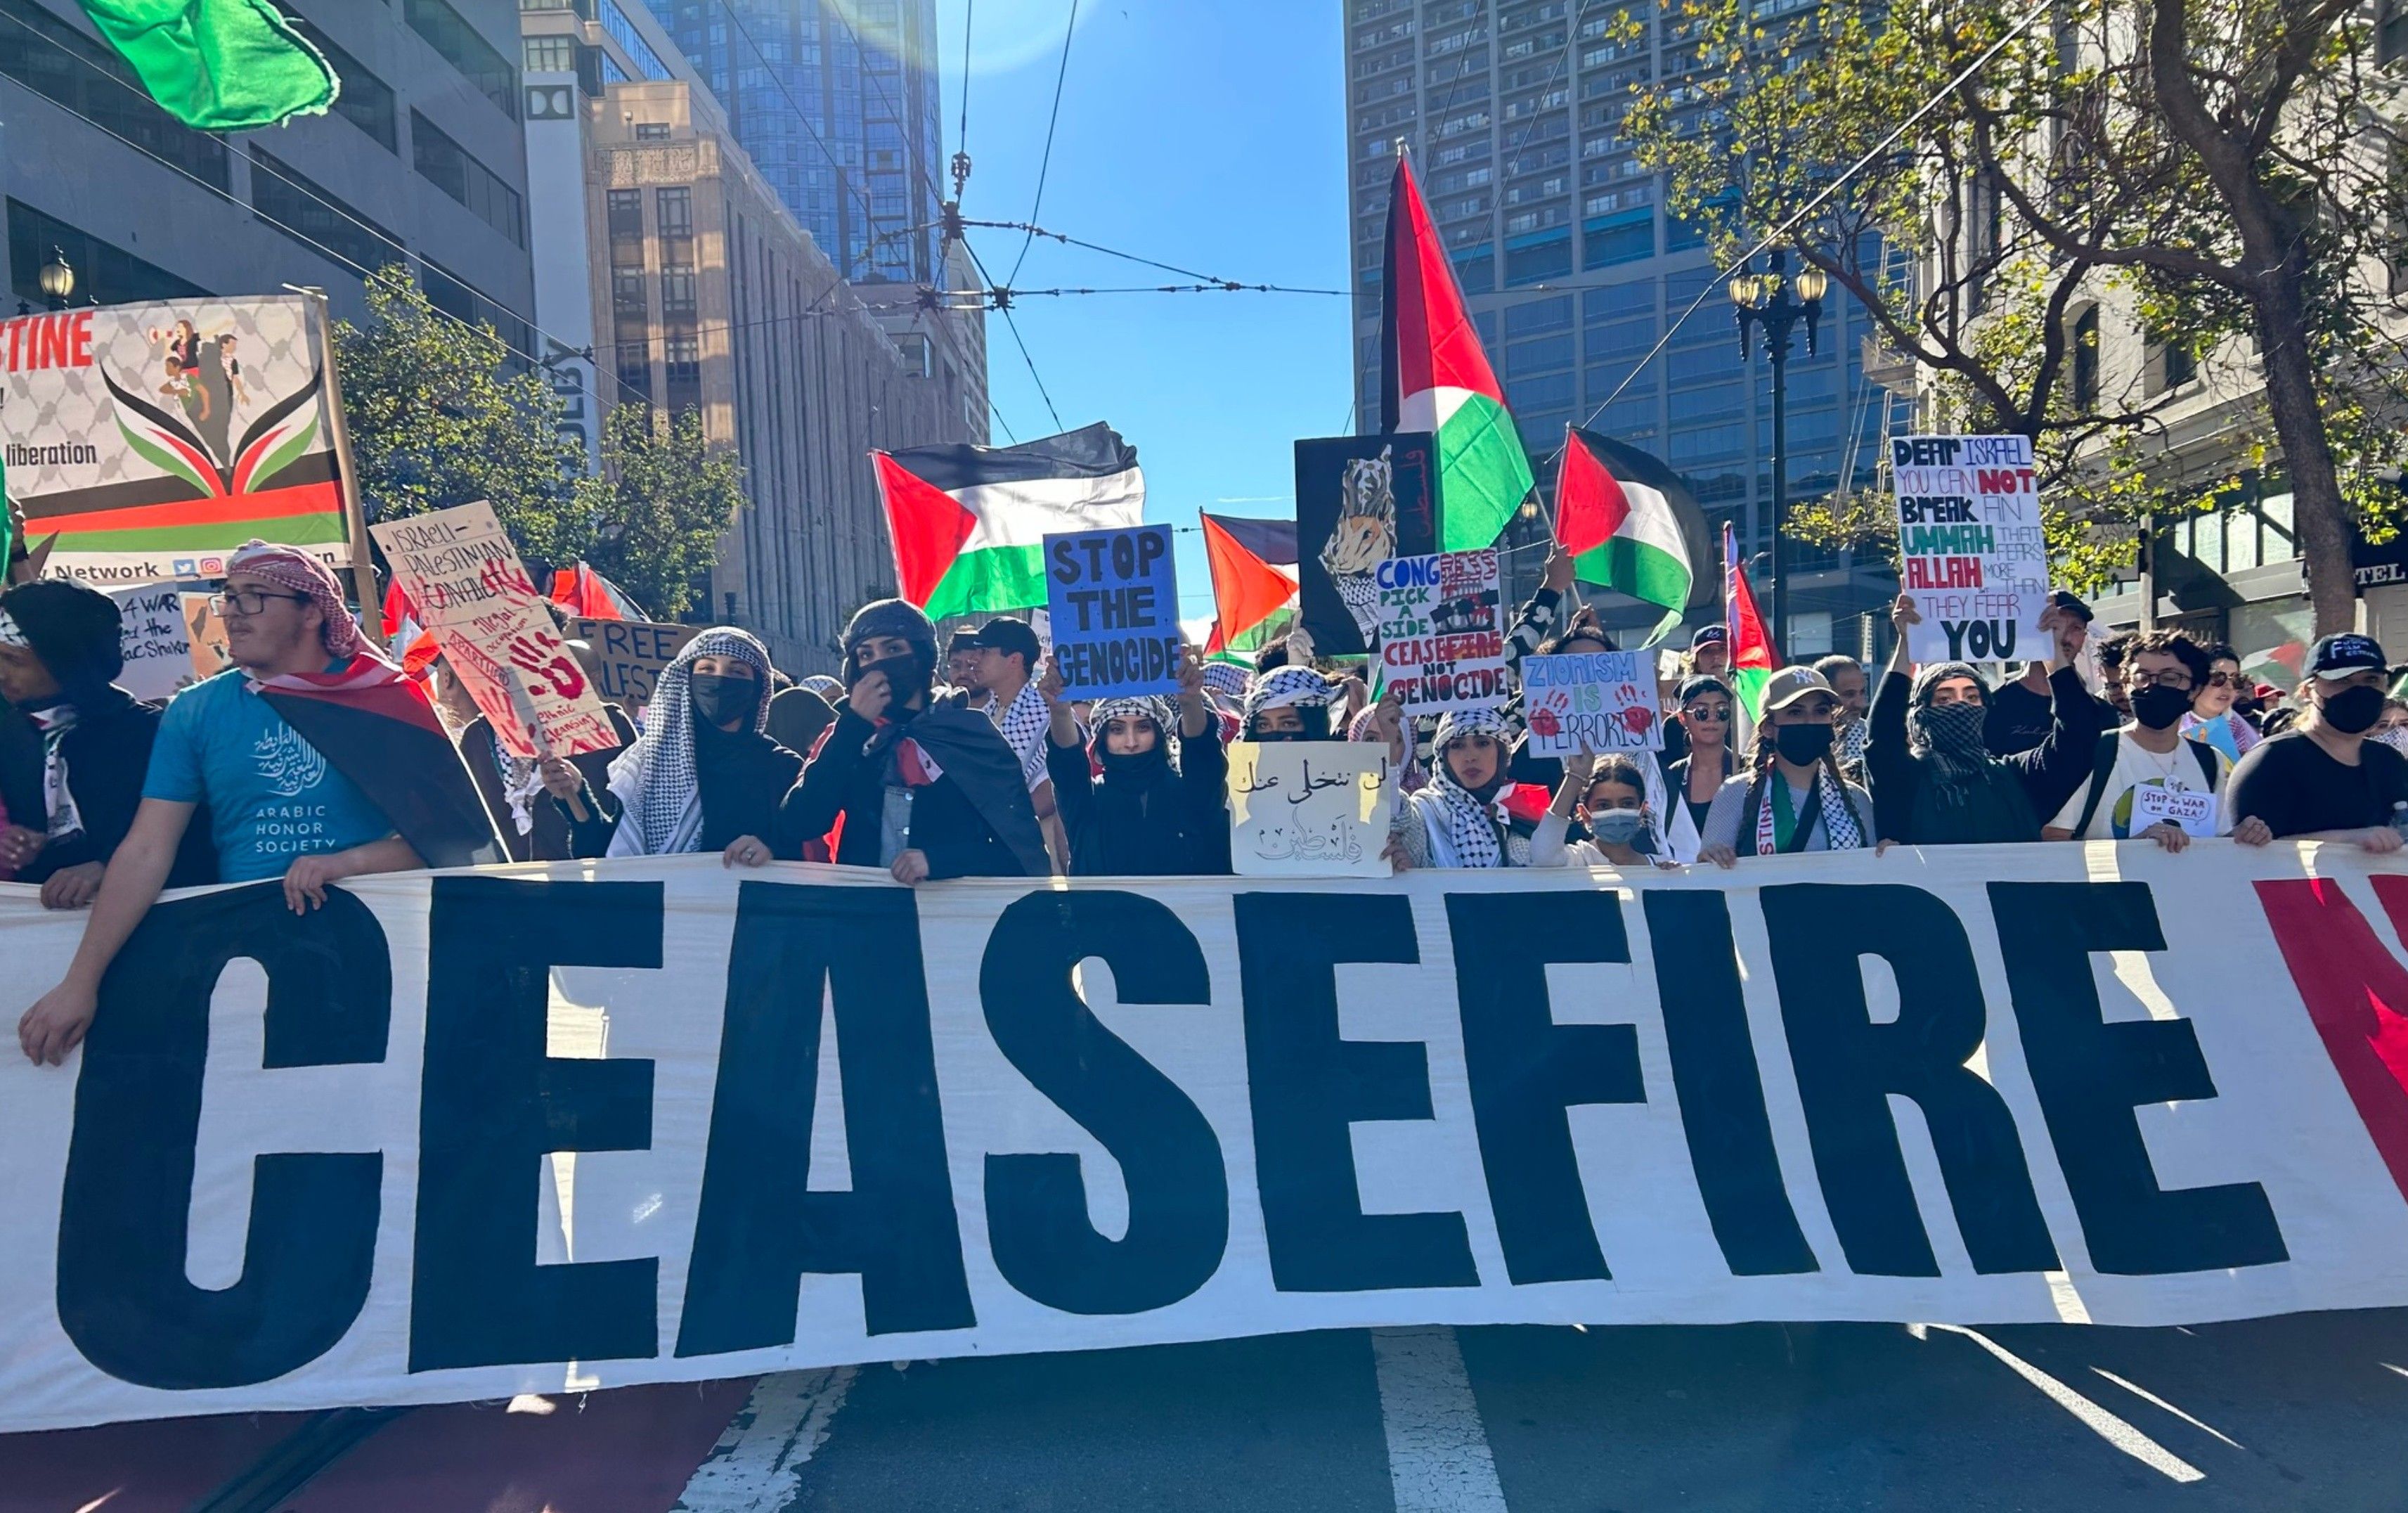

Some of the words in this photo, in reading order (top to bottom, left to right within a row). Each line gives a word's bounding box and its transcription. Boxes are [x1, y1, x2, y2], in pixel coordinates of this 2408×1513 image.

[0, 310, 94, 373] TINE
[6, 441, 97, 467] liberation
[1963, 438, 2033, 465] ISRAEL
[1898, 469, 1929, 494] YOU
[1938, 469, 1974, 494] CAN
[1978, 469, 2037, 494] NOT
[1983, 496, 2022, 522] AN
[1901, 525, 1995, 556] UMMAH
[1998, 527, 2040, 542] THAT
[1996, 543, 2043, 562] FEARS
[55, 562, 160, 579] Network
[1053, 532, 1165, 585] STOP
[1377, 549, 1497, 589] CONGRESS
[1907, 557, 1983, 589] ALLAH
[1984, 562, 2016, 579] MORE
[2354, 563, 2406, 584] TEL
[1380, 587, 1430, 606] PICK
[2000, 578, 2045, 595] THAN
[140, 593, 180, 612] WAR
[1066, 586, 1156, 631] THE
[1398, 605, 1413, 619] A
[1922, 596, 1968, 619] THEY
[1974, 594, 2022, 619] FEAR
[578, 622, 678, 661] FREE
[1381, 619, 1429, 638] SIDE
[1940, 619, 2017, 661] YOU
[1054, 637, 1180, 687] GENOCIDE
[1384, 631, 1503, 667] CEASEFIRE
[1423, 662, 1456, 676] NOT
[1387, 668, 1506, 705] GENOCIDE
[1573, 683, 1602, 713] IS
[1235, 761, 1279, 793] عنك
[1288, 758, 1351, 804] نتخلى
[1364, 756, 1387, 790] لن
[256, 806, 326, 818] ARABIC
[2182, 798, 2205, 809] WAR
[256, 823, 323, 835] HONOR
[256, 839, 336, 853] SOCIETY
[57, 877, 2290, 1390] CEASEFIRE
